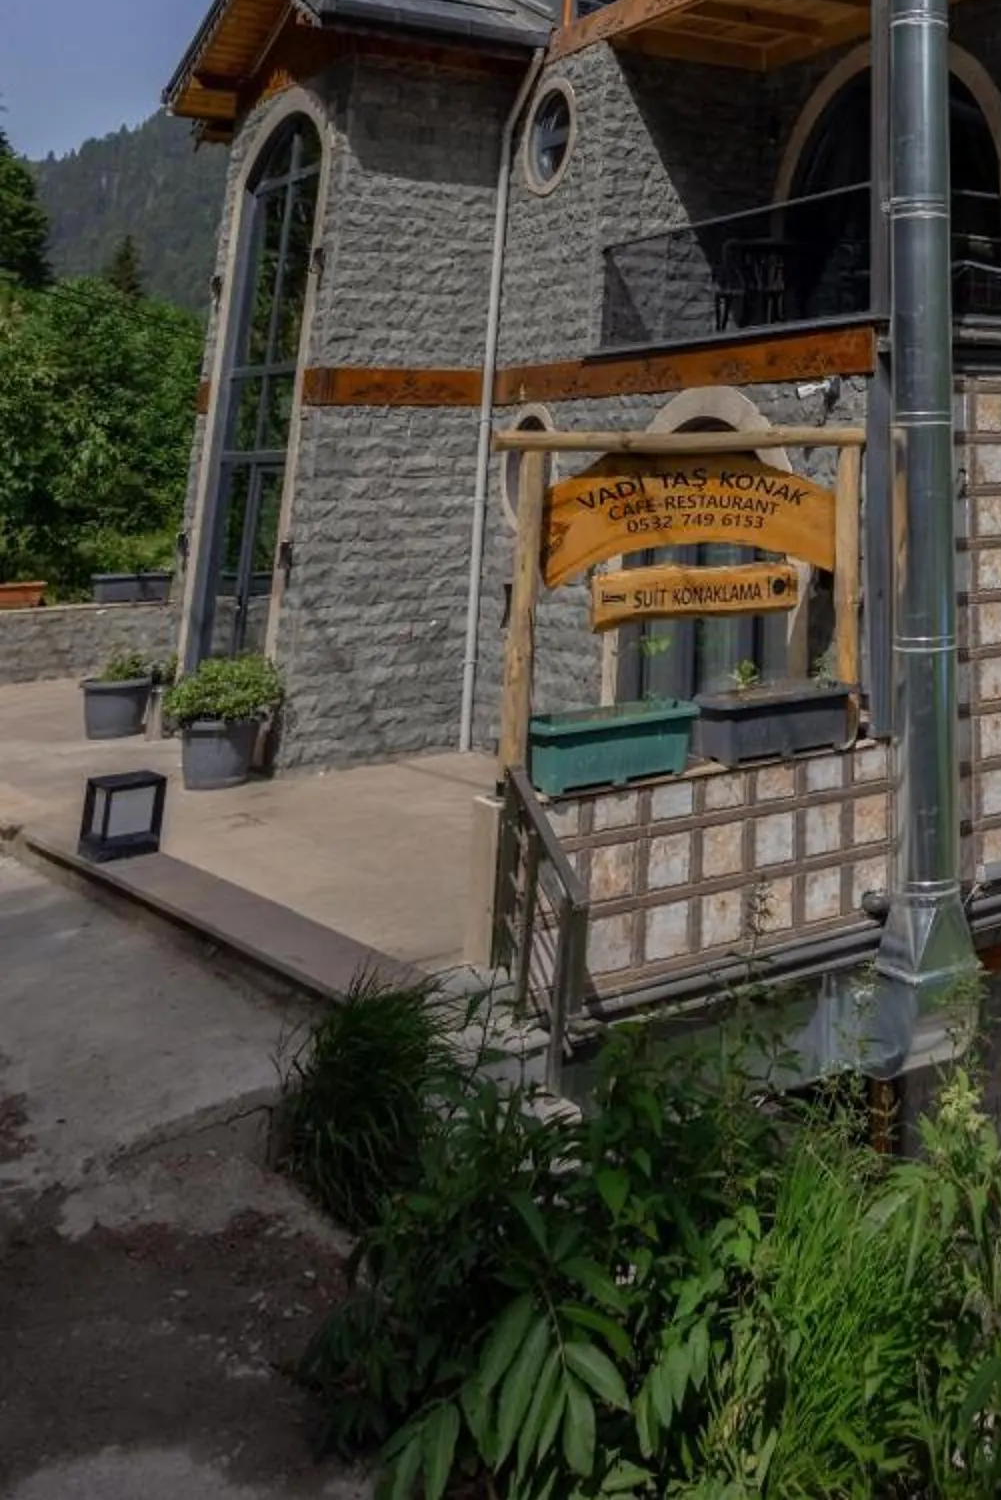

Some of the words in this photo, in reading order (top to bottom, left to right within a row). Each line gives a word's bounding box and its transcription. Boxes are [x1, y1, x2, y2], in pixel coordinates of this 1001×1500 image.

[657, 467, 708, 492] TAŞ
[719, 472, 811, 506] KONAK
[626, 516, 673, 533] 0532
[682, 513, 715, 526] 749
[721, 513, 766, 529] 6153
[672, 582, 762, 606] KONAKLAMA
